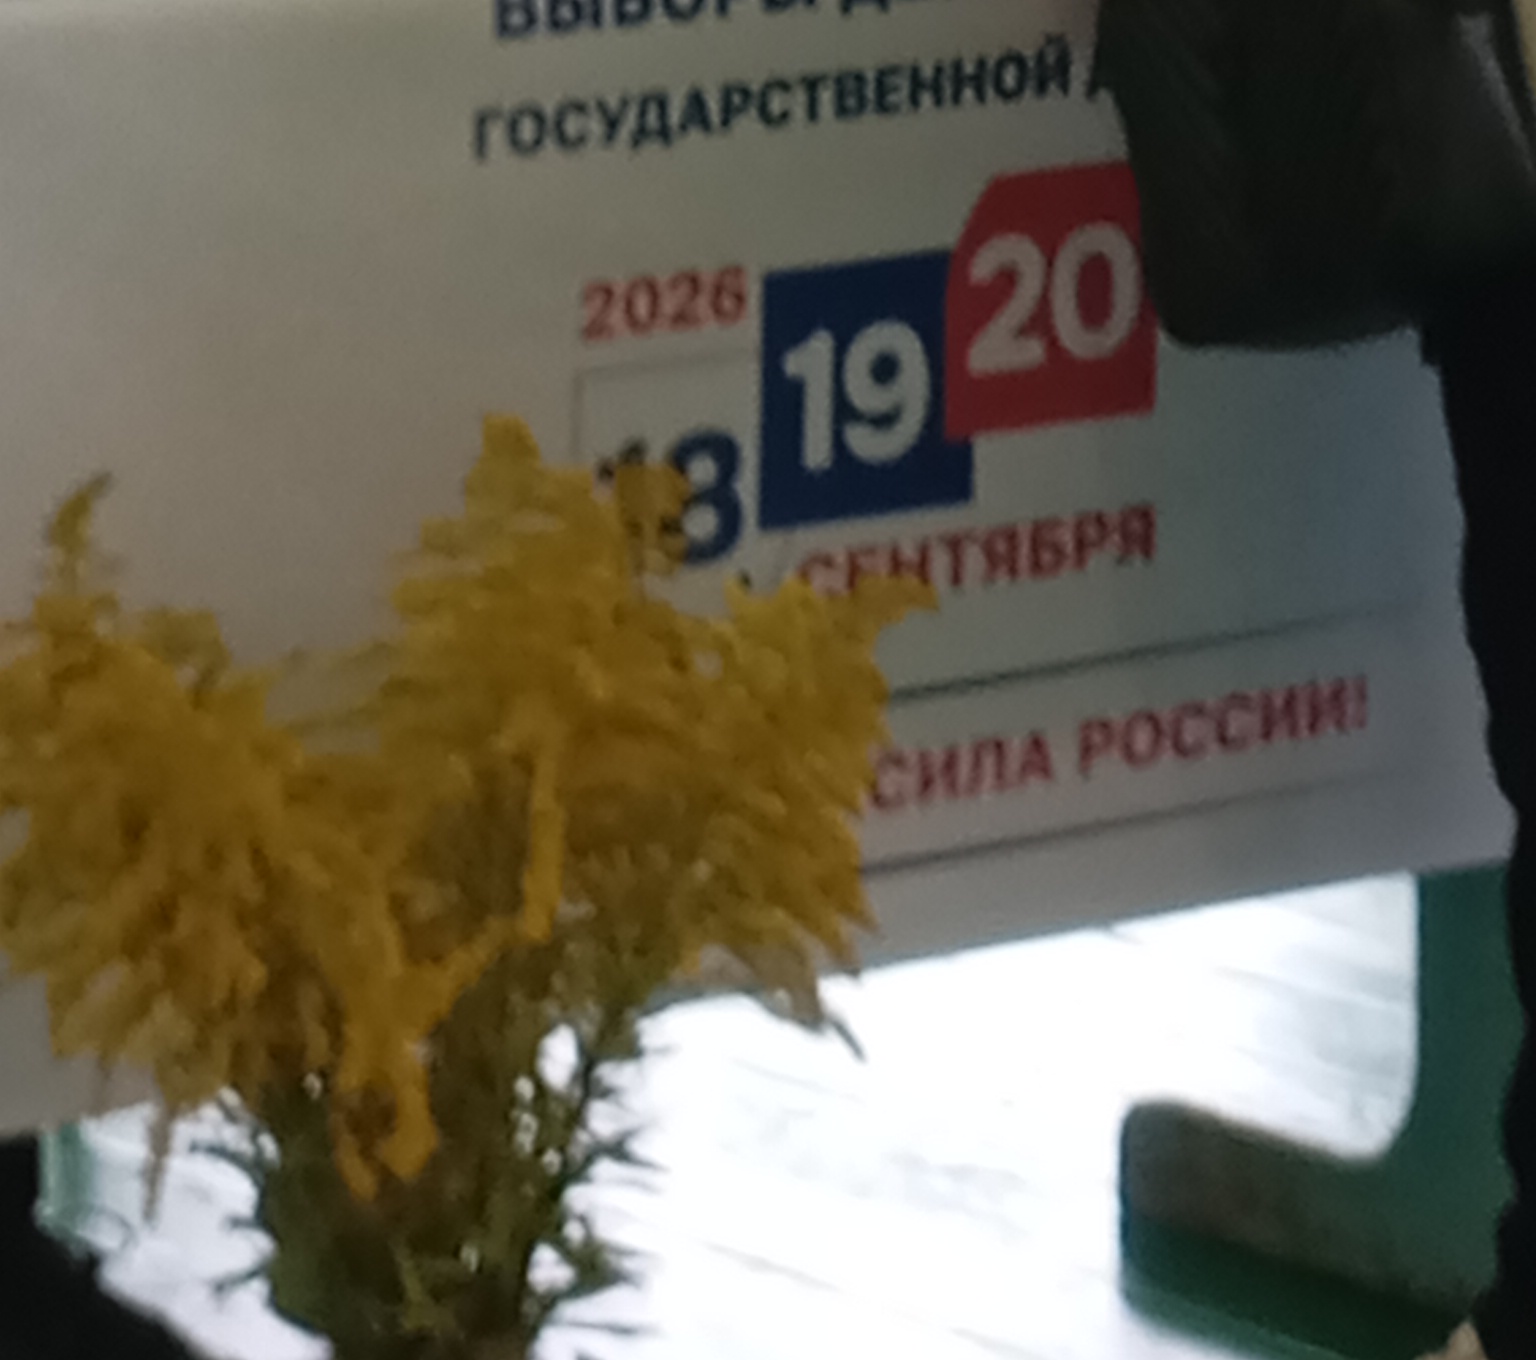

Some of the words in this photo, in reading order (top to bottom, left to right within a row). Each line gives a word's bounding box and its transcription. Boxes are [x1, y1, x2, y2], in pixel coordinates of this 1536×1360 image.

[472, 32, 1073, 162] ГОСУДАРСТВЕННОЙ
[580, 264, 749, 342] 2026
[596, 428, 742, 567] 8
[781, 317, 932, 473] 19
[965, 220, 1144, 380] 20
[868, 727, 1057, 812] СИЛА
[1076, 673, 1371, 782] РОССИИ!
